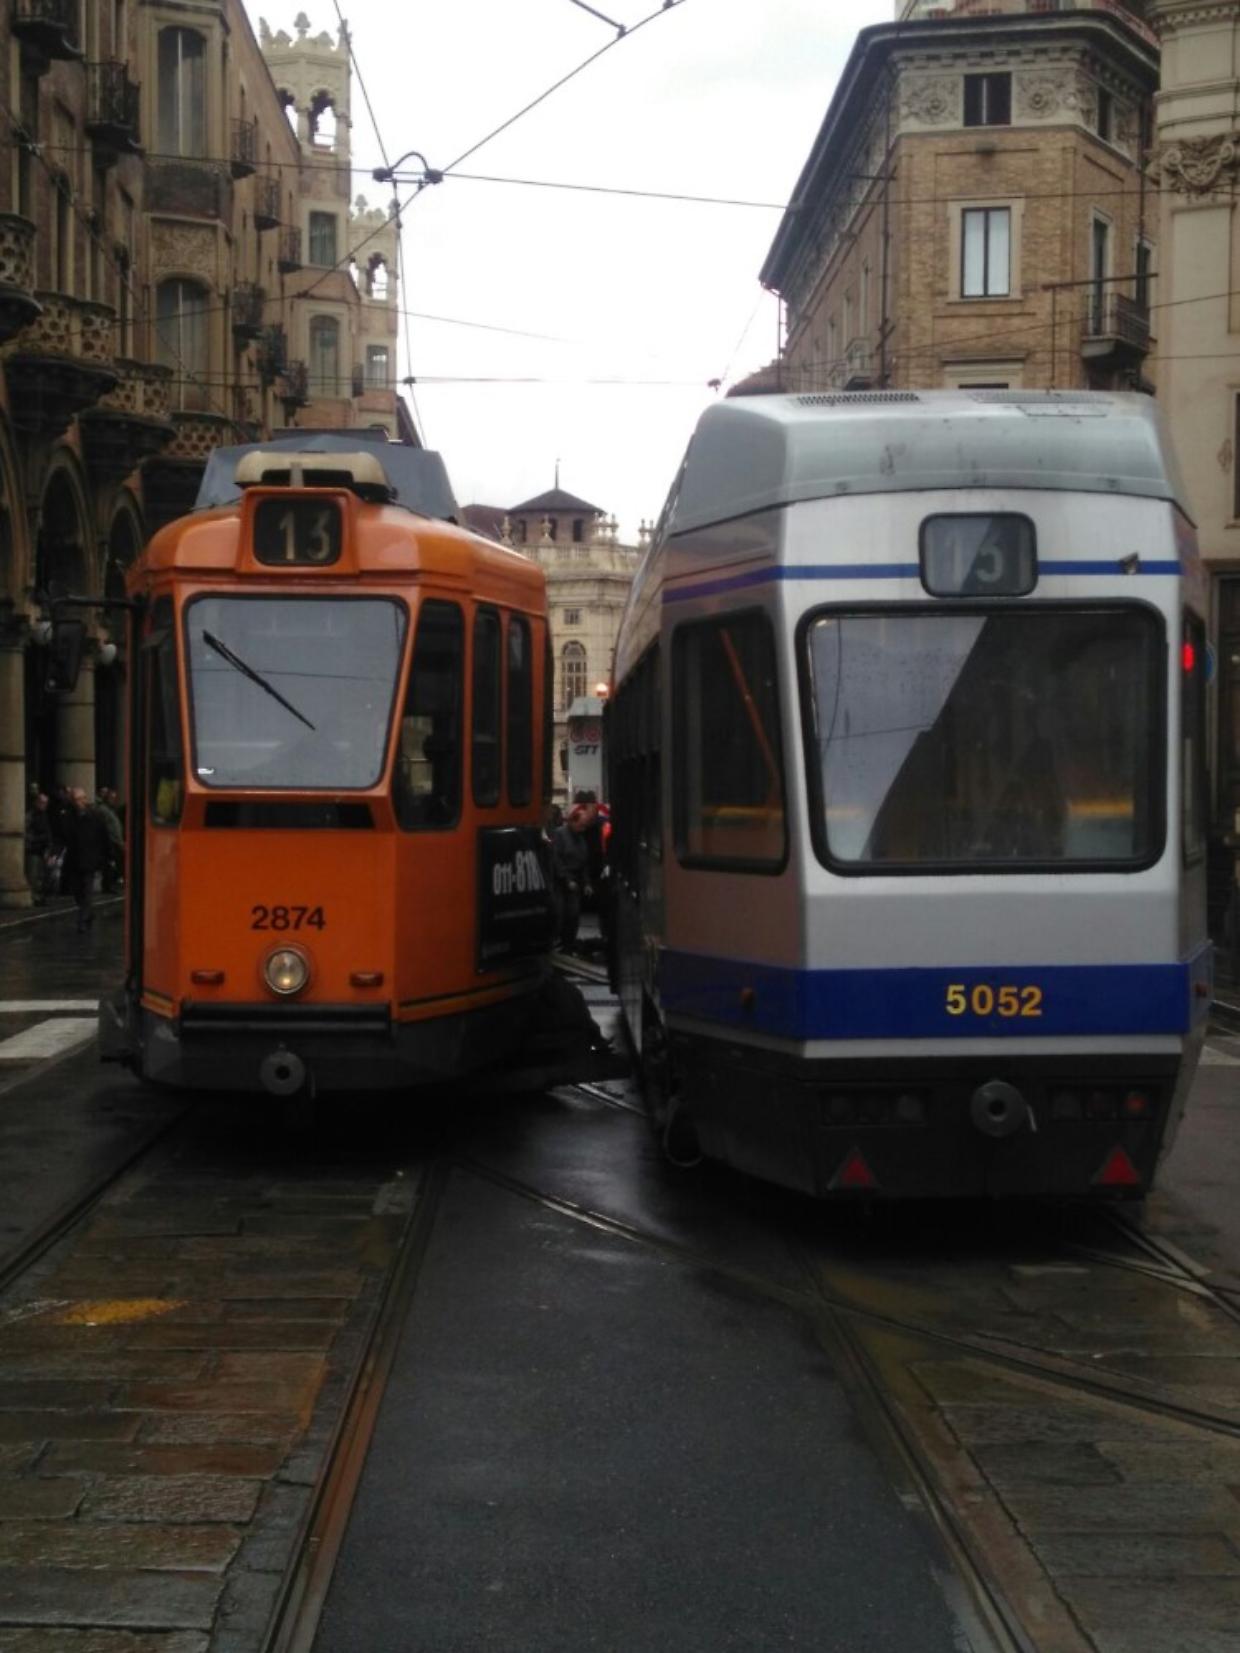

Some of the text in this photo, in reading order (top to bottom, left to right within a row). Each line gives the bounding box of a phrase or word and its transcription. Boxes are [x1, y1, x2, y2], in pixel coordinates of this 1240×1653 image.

[279, 507, 331, 561] 13
[250, 904, 327, 931] 2874
[945, 983, 1043, 1017] 5052
